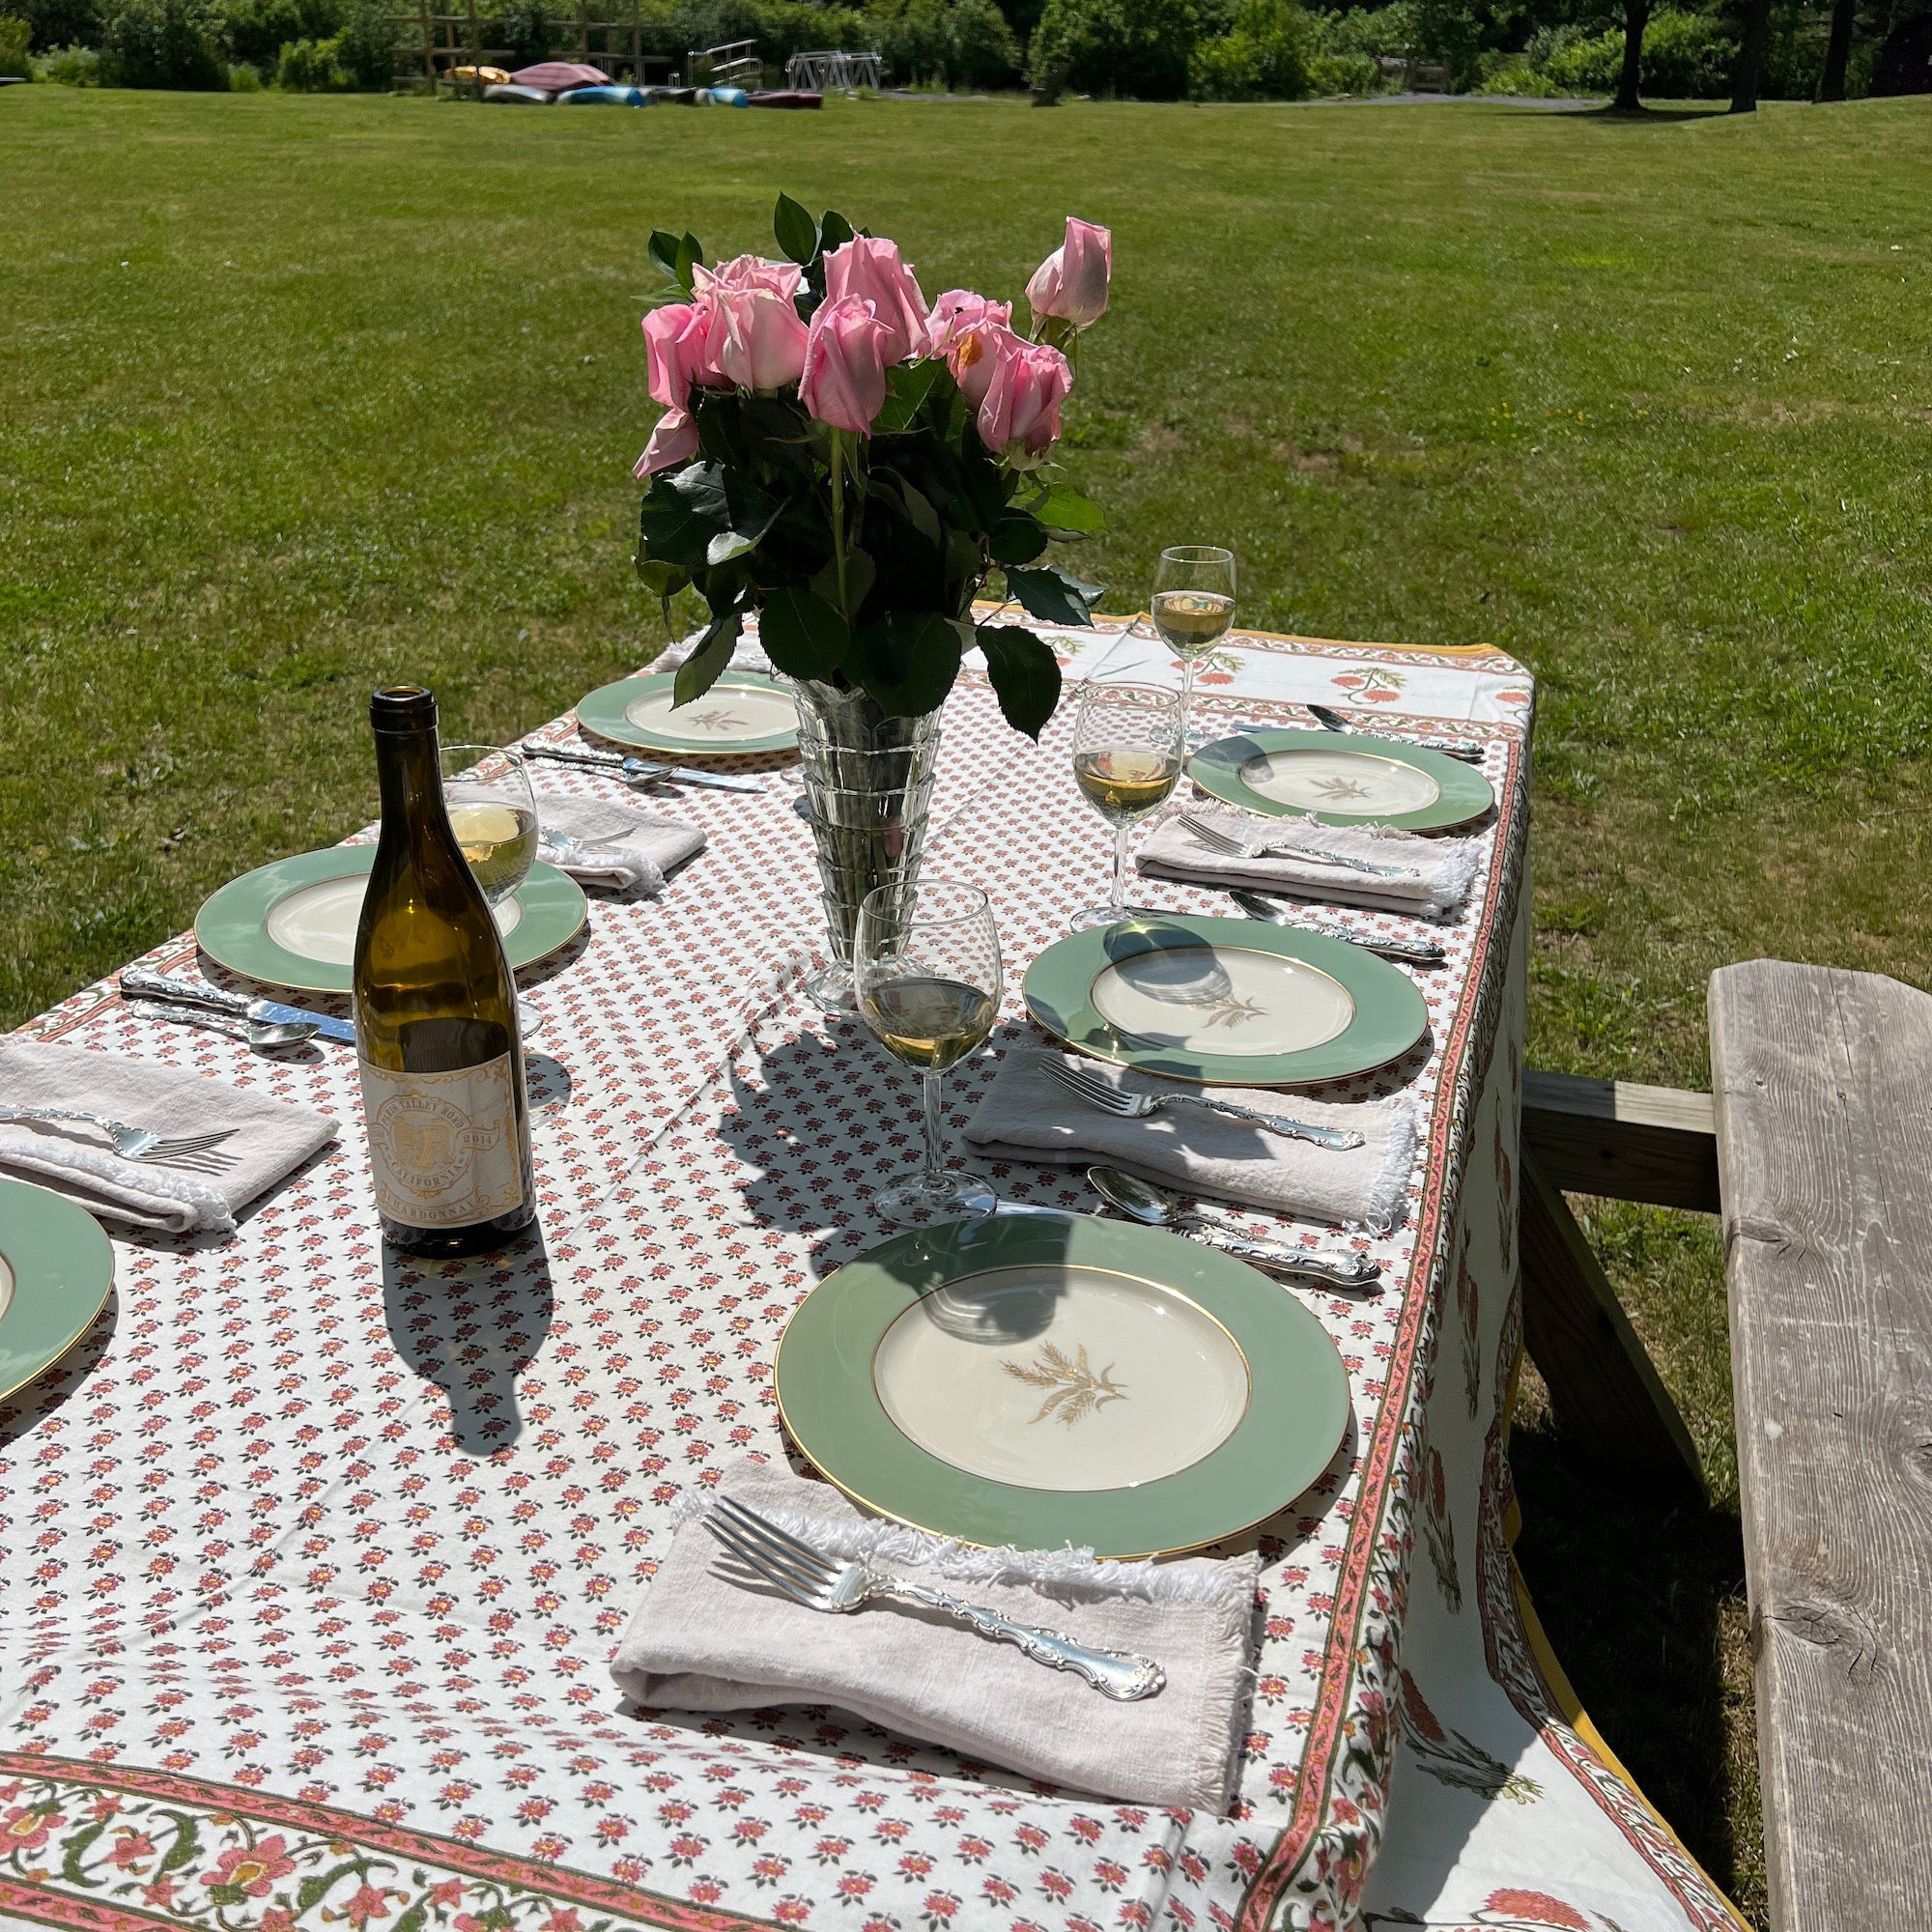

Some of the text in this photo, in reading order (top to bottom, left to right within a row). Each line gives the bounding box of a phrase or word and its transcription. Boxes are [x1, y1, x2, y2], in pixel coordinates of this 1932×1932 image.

[399, 1099, 440, 1111] VALLEY
[442, 1106, 465, 1128] ROAD
[463, 1134, 492, 1145] 2014
[391, 1161, 462, 1187] CALIFORNIA
[387, 1194, 474, 1220] CHARDONNAY
